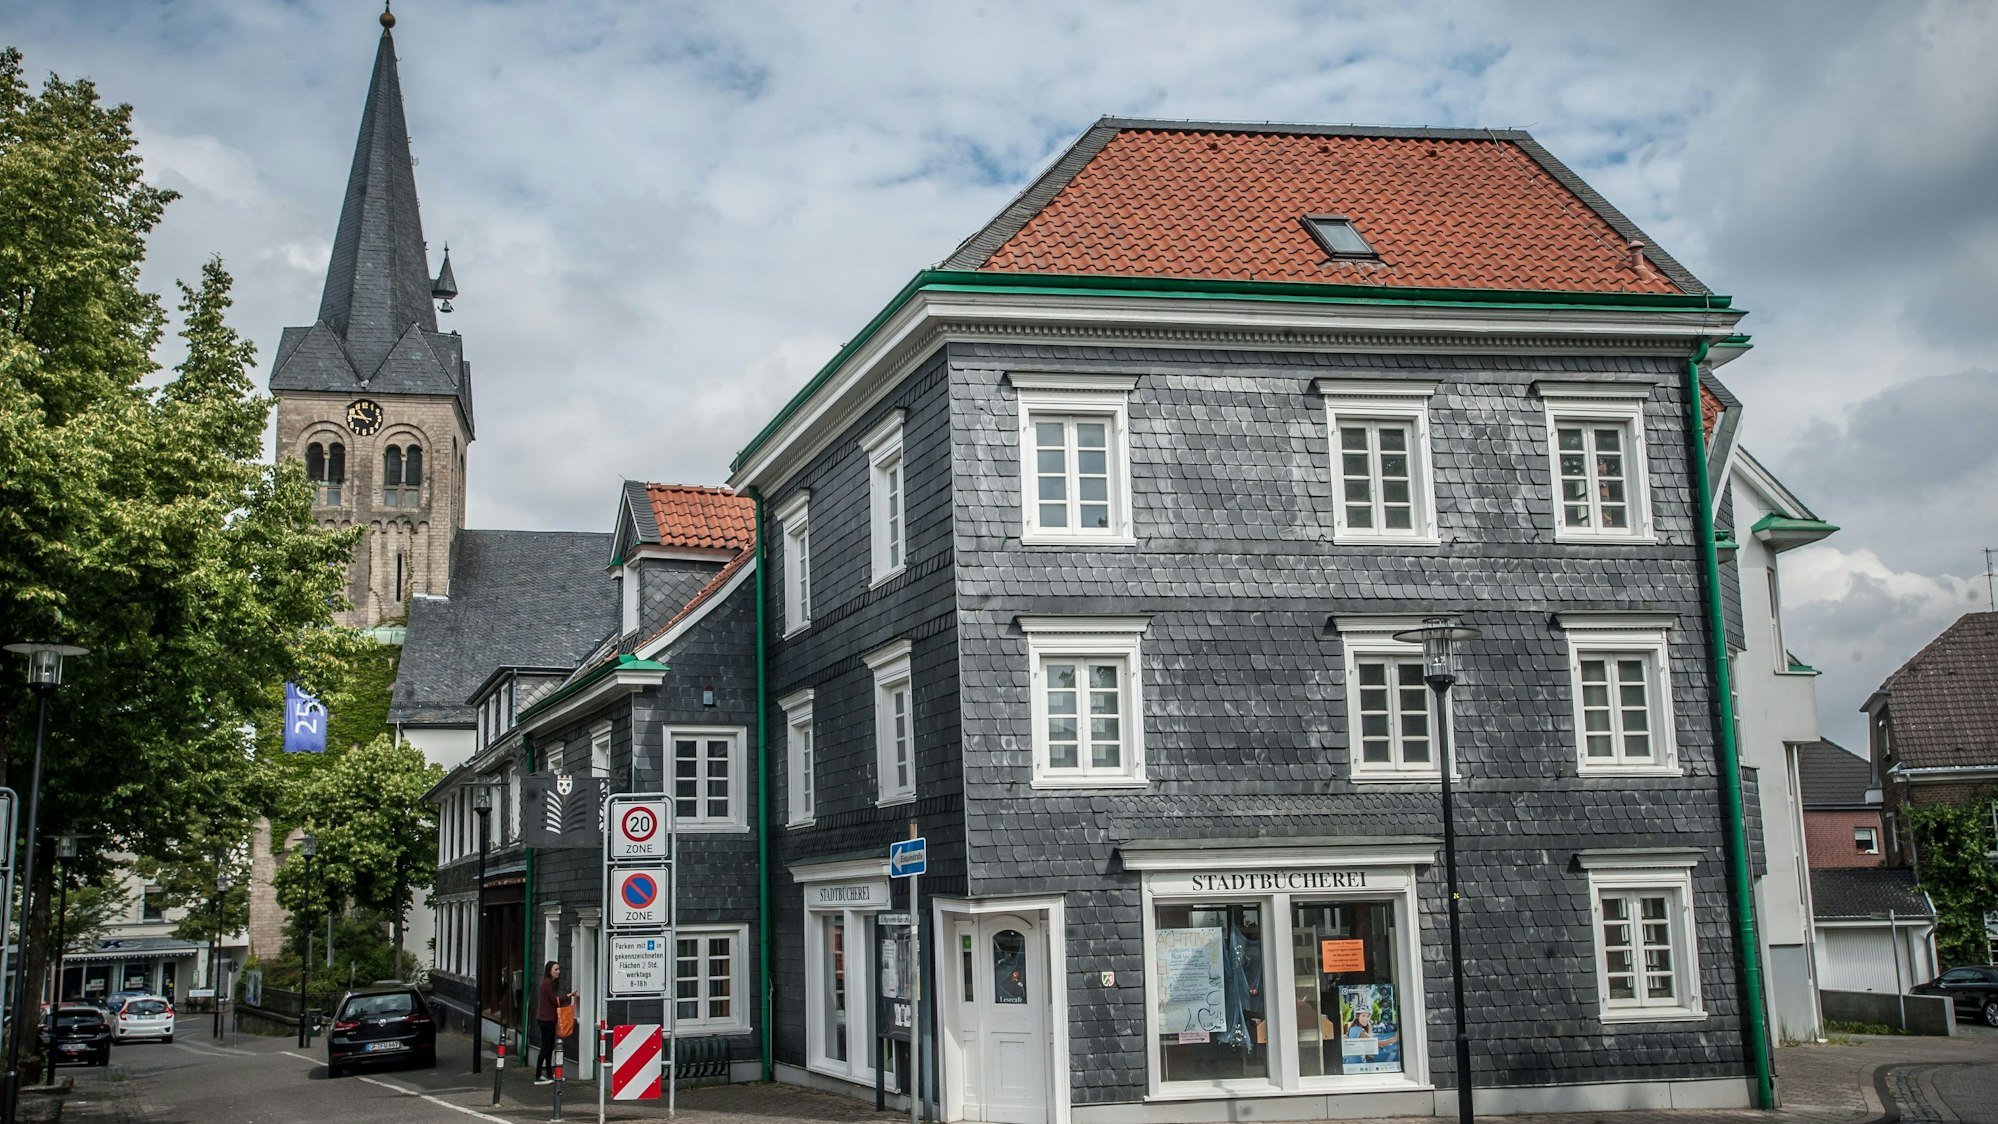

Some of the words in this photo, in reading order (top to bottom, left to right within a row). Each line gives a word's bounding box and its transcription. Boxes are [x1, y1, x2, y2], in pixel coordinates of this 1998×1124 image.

[630, 816, 650, 833] 20
[626, 844, 653, 854] ZONE
[1192, 870, 1367, 891] STADTBÜCHEREI
[820, 885, 870, 901] STADTBÜCHEREI
[625, 911, 653, 921] ZONE
[614, 952, 663, 961] gekennzeichneten
[619, 961, 641, 969] Flächen
[647, 961, 658, 969] Std.
[626, 971, 652, 979] werktags
